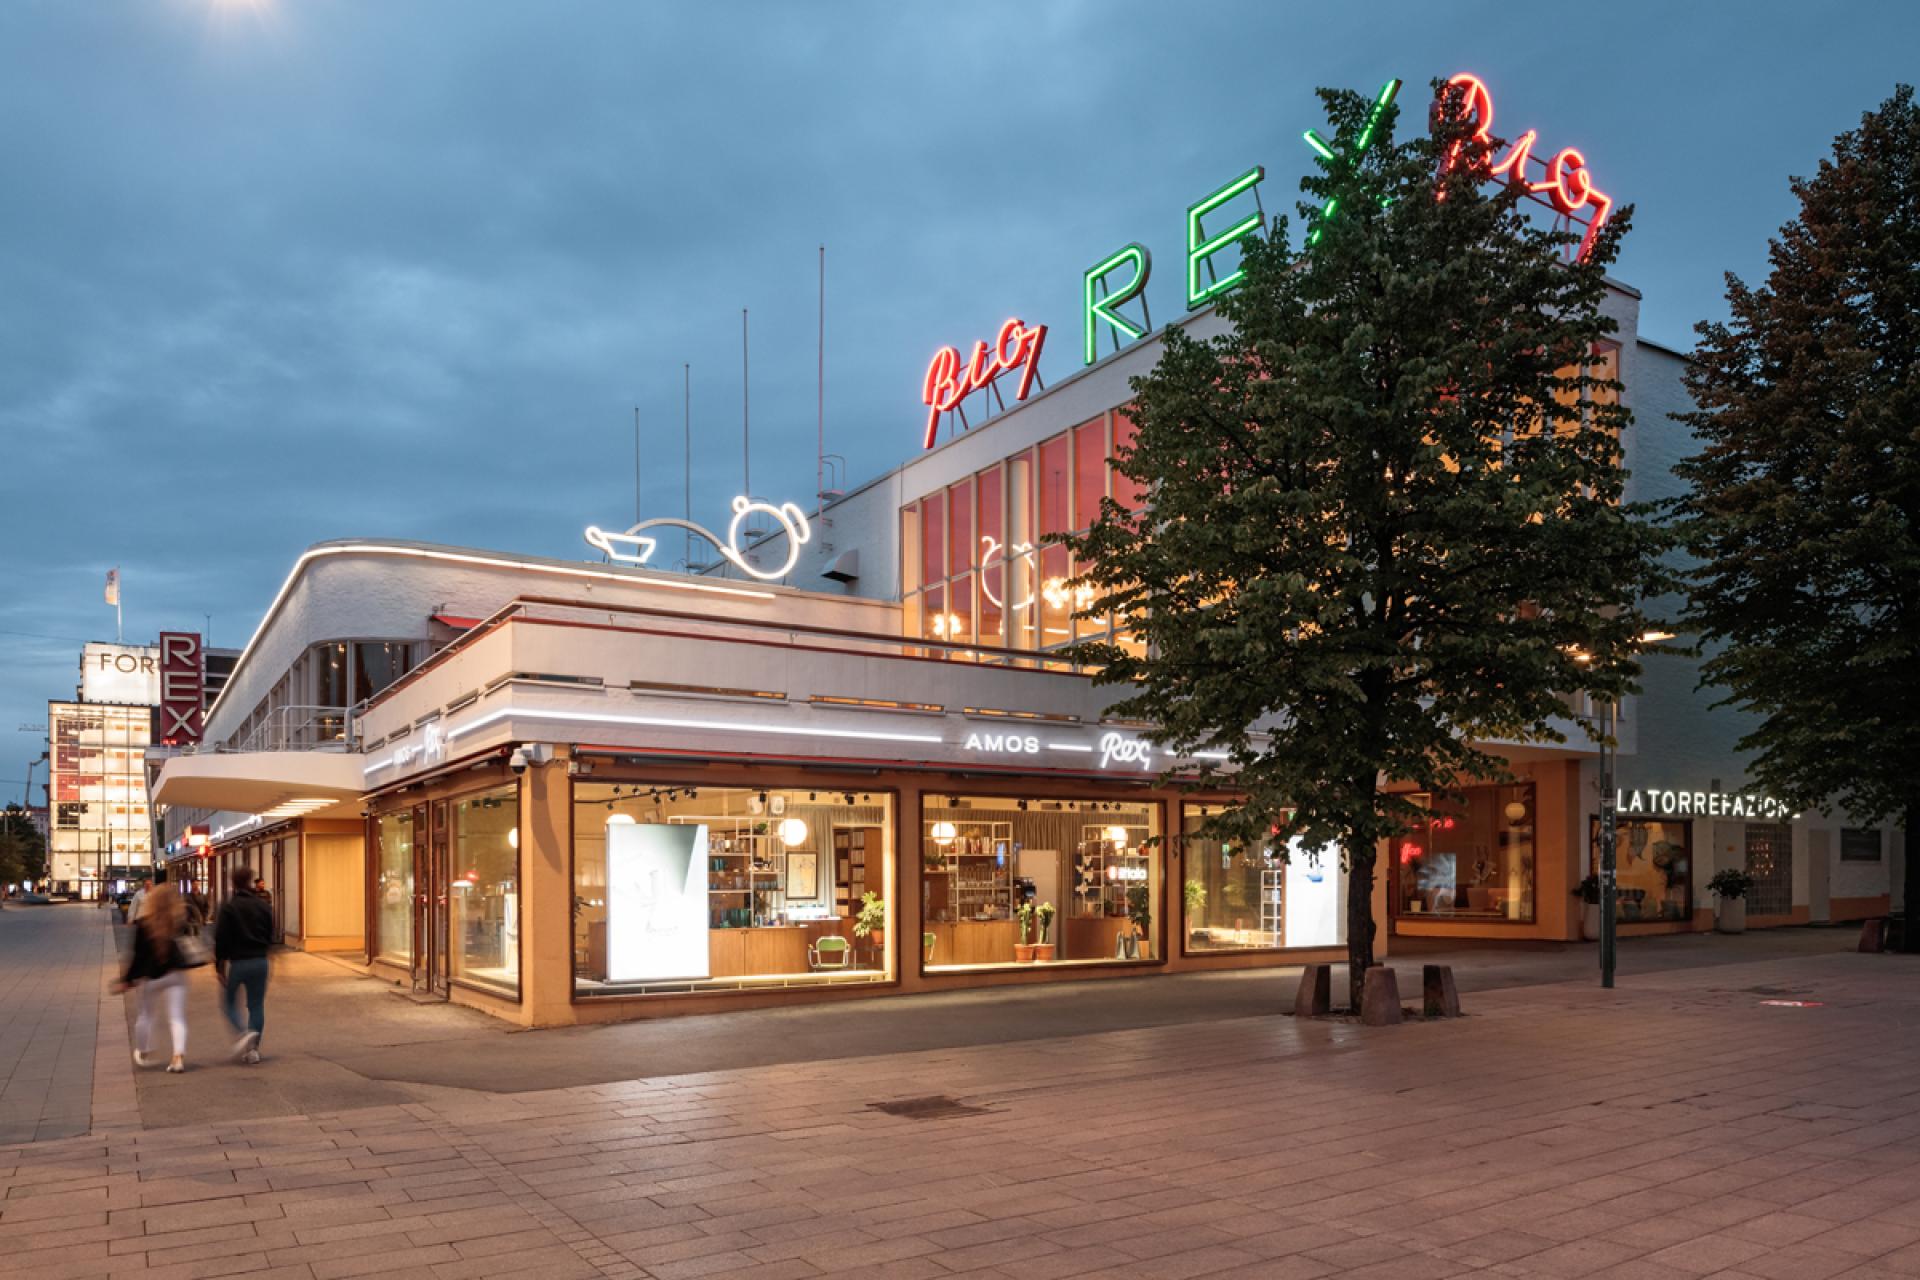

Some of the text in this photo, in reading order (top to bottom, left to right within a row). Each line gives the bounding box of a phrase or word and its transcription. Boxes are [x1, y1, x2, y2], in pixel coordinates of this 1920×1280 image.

[100, 653, 160, 674] FOR
[162, 635, 198, 737] REX
[964, 732, 1151, 771] AMOS Rex
[1616, 788, 1643, 812] LA
